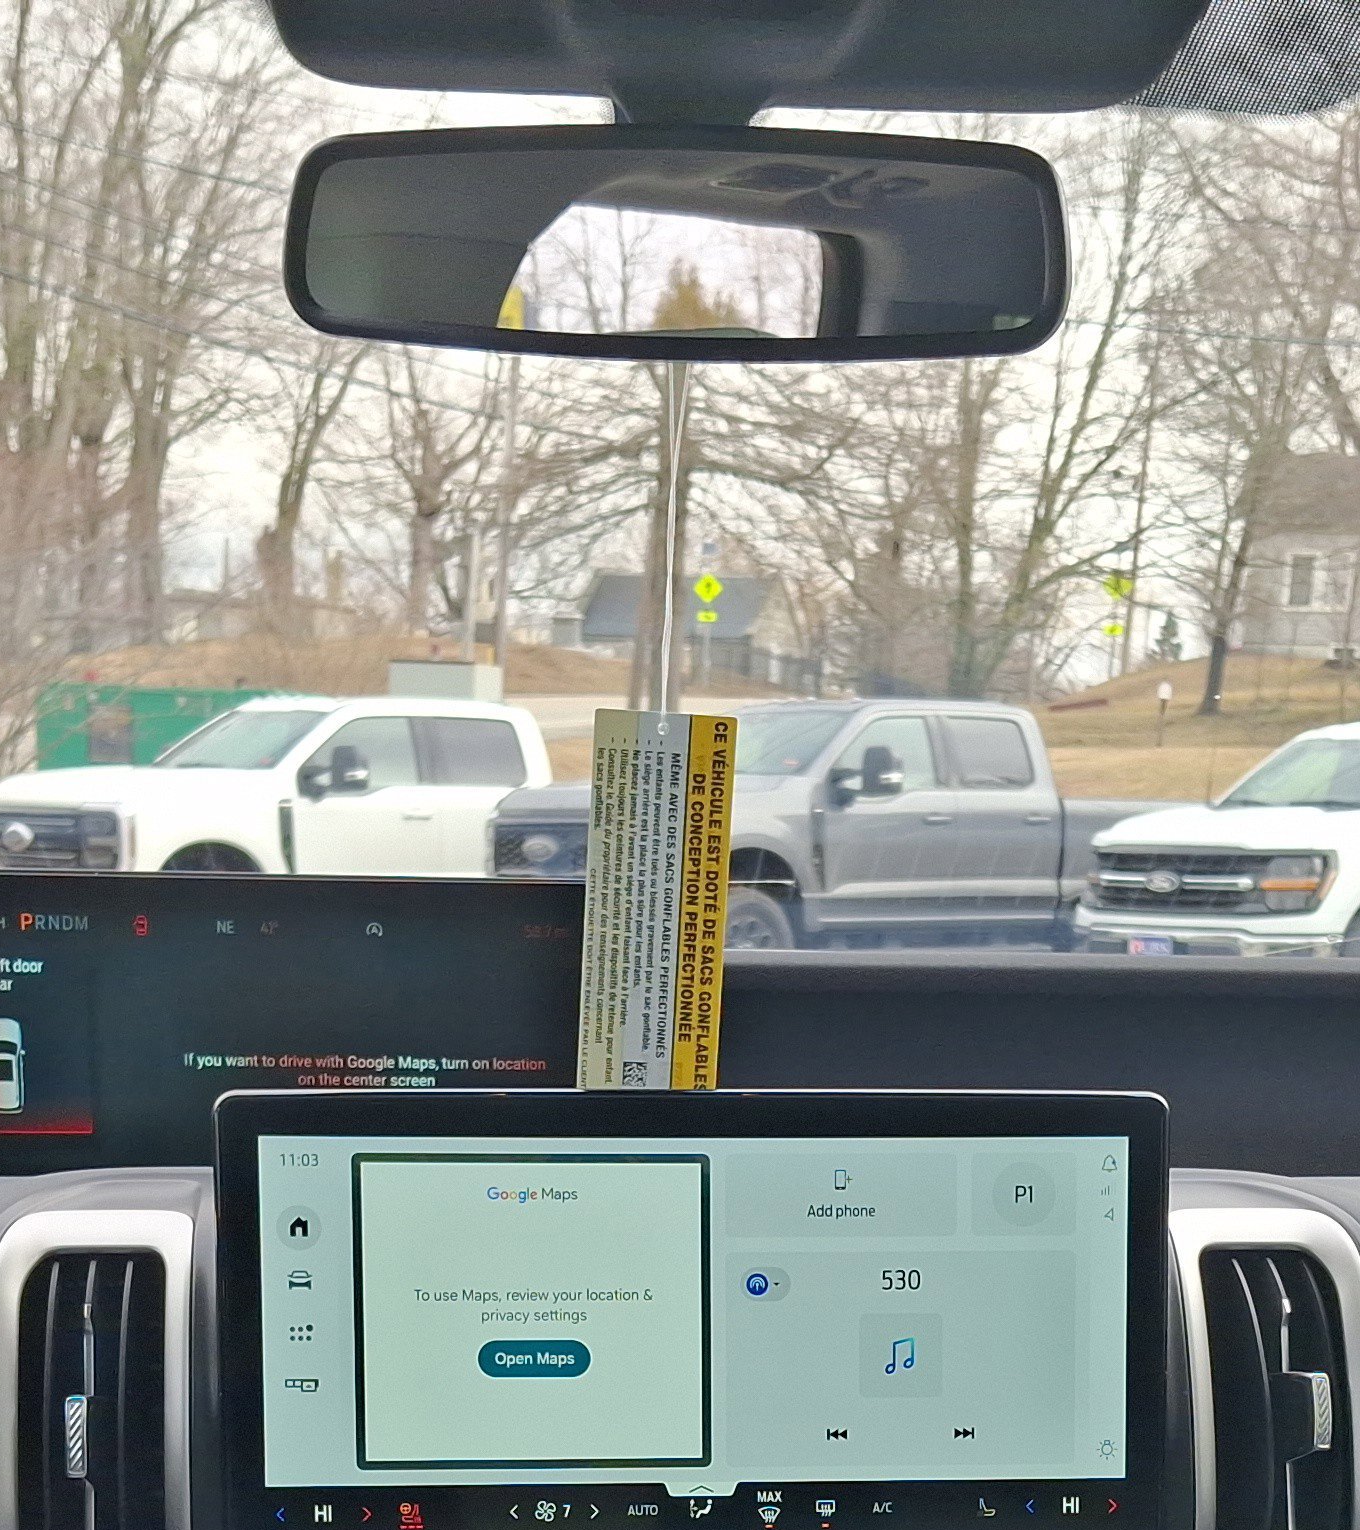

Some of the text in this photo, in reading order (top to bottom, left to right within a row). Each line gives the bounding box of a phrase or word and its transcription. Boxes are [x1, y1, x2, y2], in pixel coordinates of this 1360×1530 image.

[655, 752, 682, 1058] MÊME AVEC DES SACS GONFLABLES PERFECTIONNÉS
[678, 773, 706, 1042] DE CONCEPTION PERFECTIONNÉE
[694, 721, 728, 1090] CE VÉHICULE EST DOTÉ DE SACS GONFLABLES
[217, 921, 234, 934] NE
[13, 958, 43, 973] door
[184, 1053, 546, 1072] If you want to drive with Google Maps, turn on location
[298, 1073, 436, 1087] on the center screen
[280, 1153, 319, 1167] 11:03
[486, 1186, 578, 1204] Google Maps
[1014, 1186, 1034, 1204] P1
[807, 1204, 876, 1221] Add phone
[881, 1269, 922, 1291] 530
[414, 1287, 653, 1304] To use Maps, review your location &
[480, 1308, 588, 1325] privacy settings
[494, 1352, 575, 1368] Open Maps
[757, 1491, 782, 1503] MAX
[1062, 1497, 1080, 1514] HI
[314, 1505, 333, 1522] HI
[562, 1504, 571, 1517] 7
[627, 1503, 659, 1517] AUTO
[872, 1501, 893, 1514] A/C
